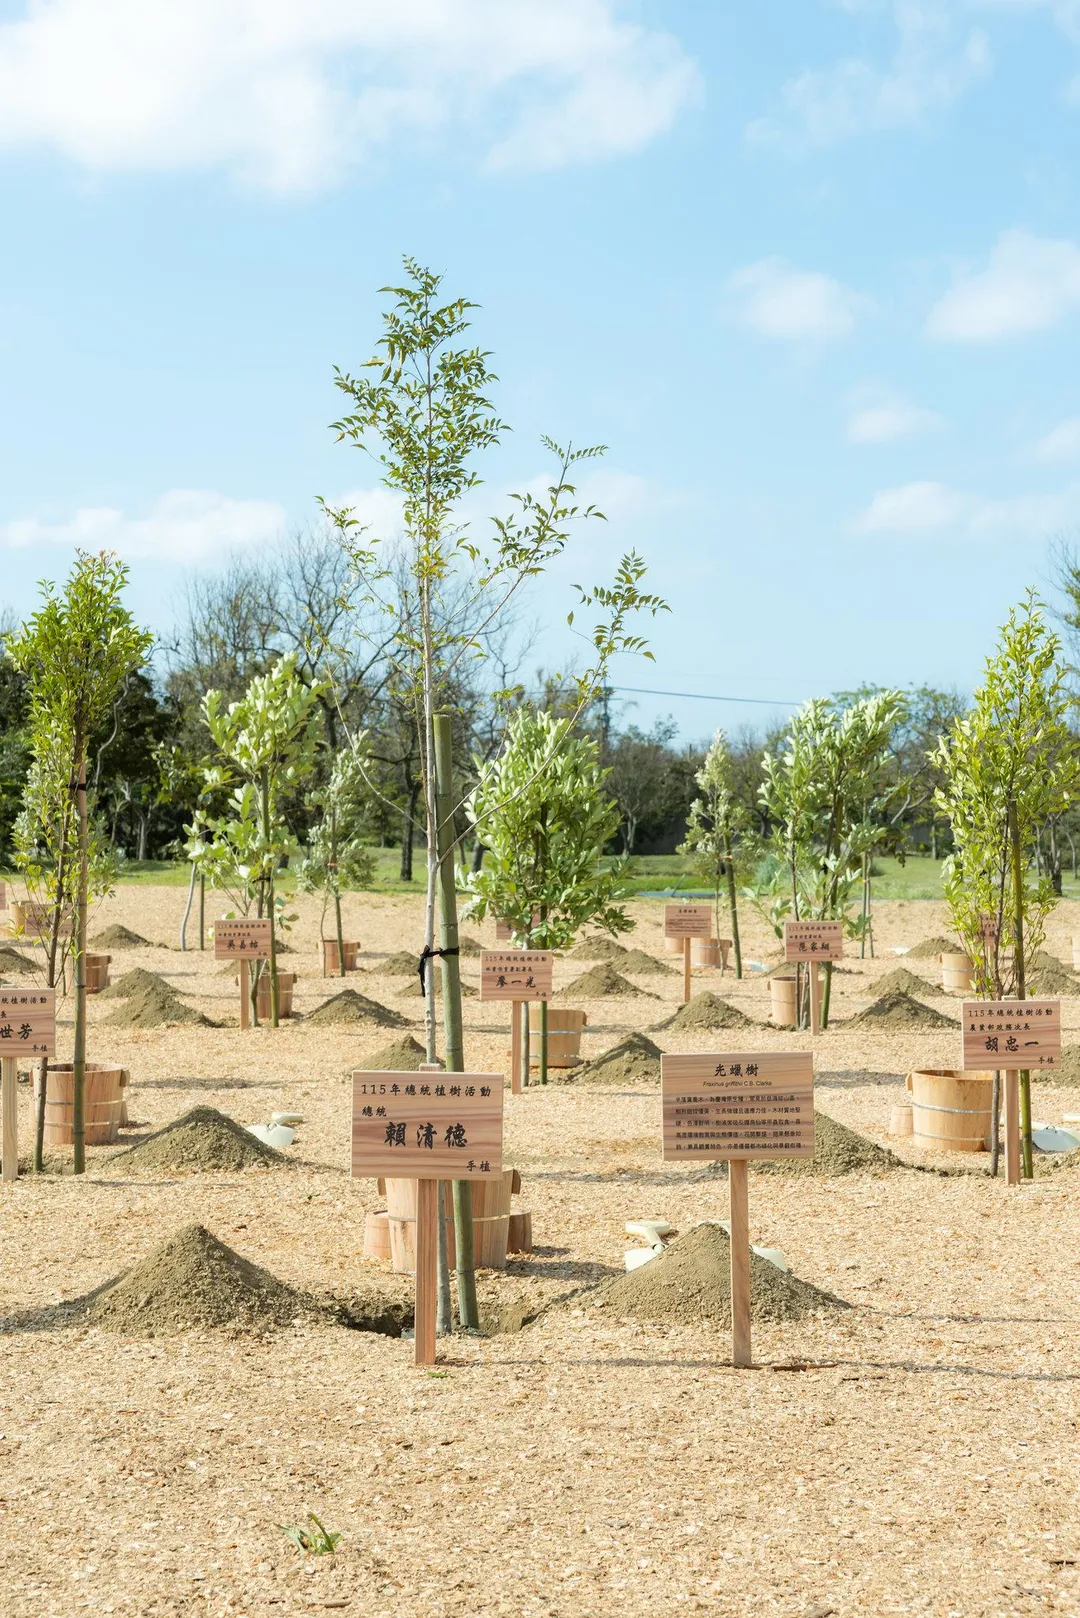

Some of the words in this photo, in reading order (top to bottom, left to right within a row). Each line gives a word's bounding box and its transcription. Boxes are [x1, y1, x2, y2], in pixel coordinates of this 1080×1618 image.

[496, 975, 536, 988] 廖一光
[968, 1008, 1053, 1018] 115年總統植樹活動
[0, 1023, 33, 1040] 世芳
[32, 1044, 48, 1052] 手植
[985, 1036, 1039, 1052] 胡忠一
[1038, 1056, 1054, 1064] 手植
[714, 1063, 759, 1077] 光蠟樹
[361, 1083, 491, 1100] 115年總統植樹活動
[362, 1105, 387, 1117] 總統
[384, 1121, 468, 1149] 賴清德
[466, 1160, 491, 1172] 手植
